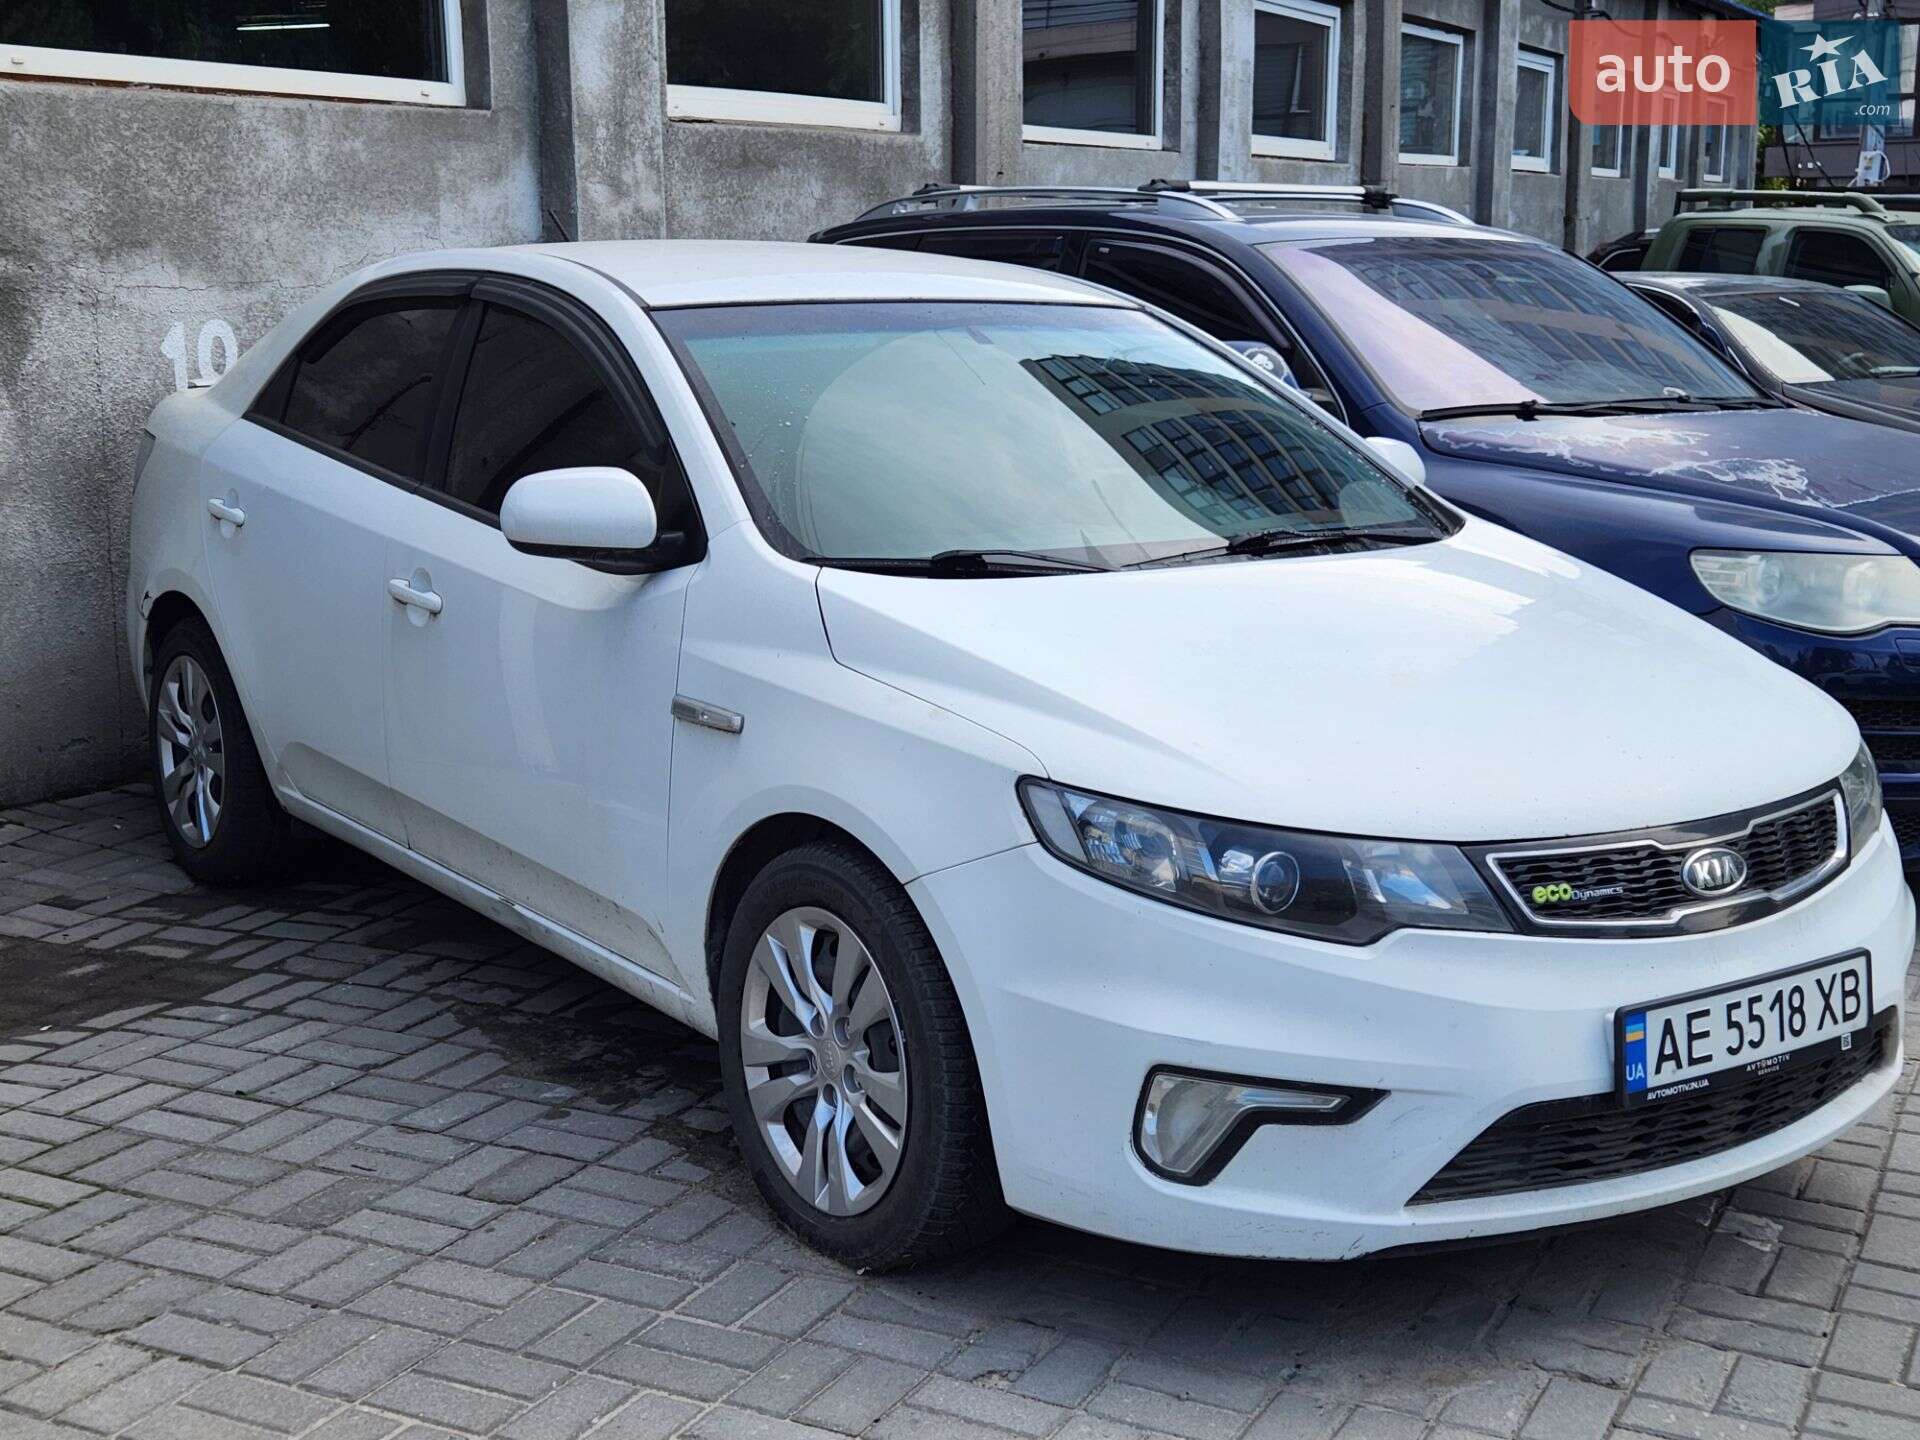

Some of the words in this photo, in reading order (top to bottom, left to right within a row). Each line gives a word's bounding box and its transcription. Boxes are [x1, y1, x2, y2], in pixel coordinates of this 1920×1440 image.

[160, 319, 239, 391] 10
[1692, 856, 1742, 889] KIA
[1654, 1008, 1713, 1076] AE
[1726, 985, 1806, 1056] 5518
[1815, 968, 1861, 1031] XB
[1626, 1063, 1645, 1082] UA
[1746, 1054, 1791, 1072] AVTOMOTIV
